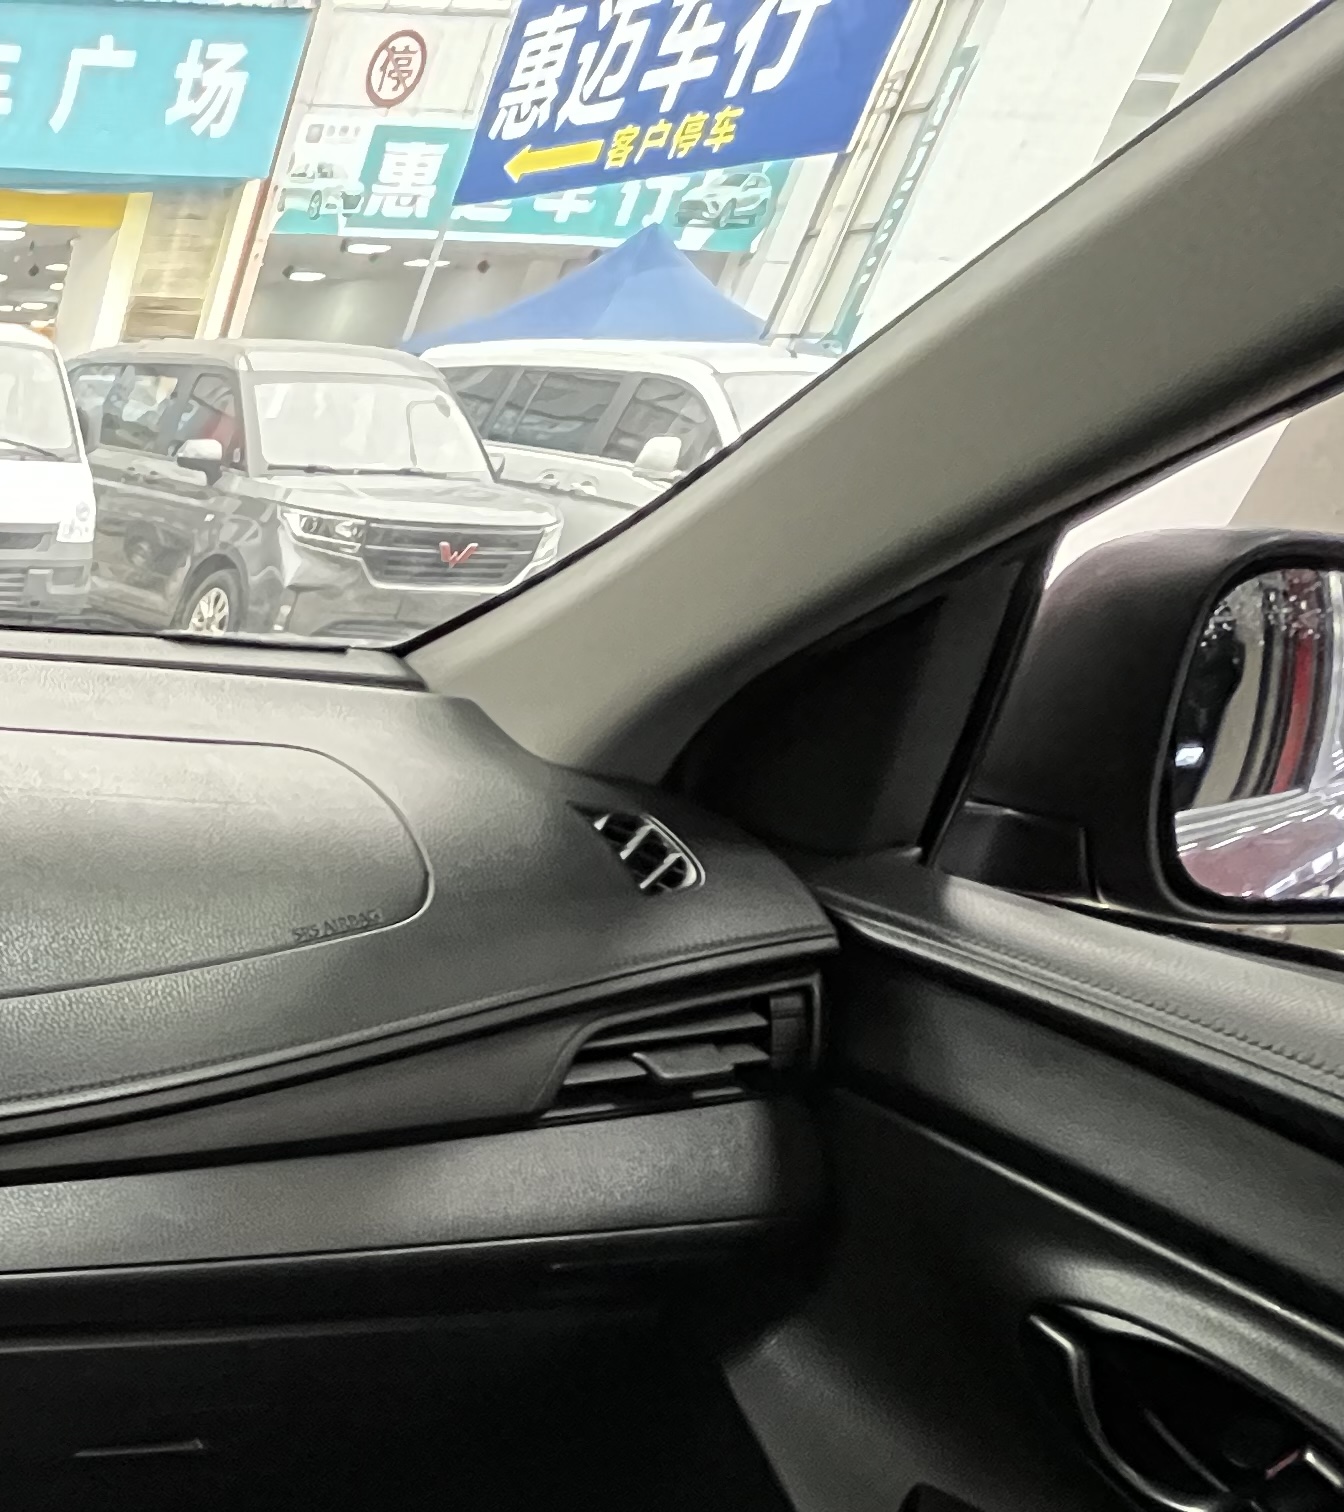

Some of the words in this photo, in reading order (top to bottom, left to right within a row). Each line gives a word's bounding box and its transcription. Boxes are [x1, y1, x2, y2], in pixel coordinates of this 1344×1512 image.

[488, 0, 834, 141] 惠迈车行
[603, 105, 745, 171] 客户停车
